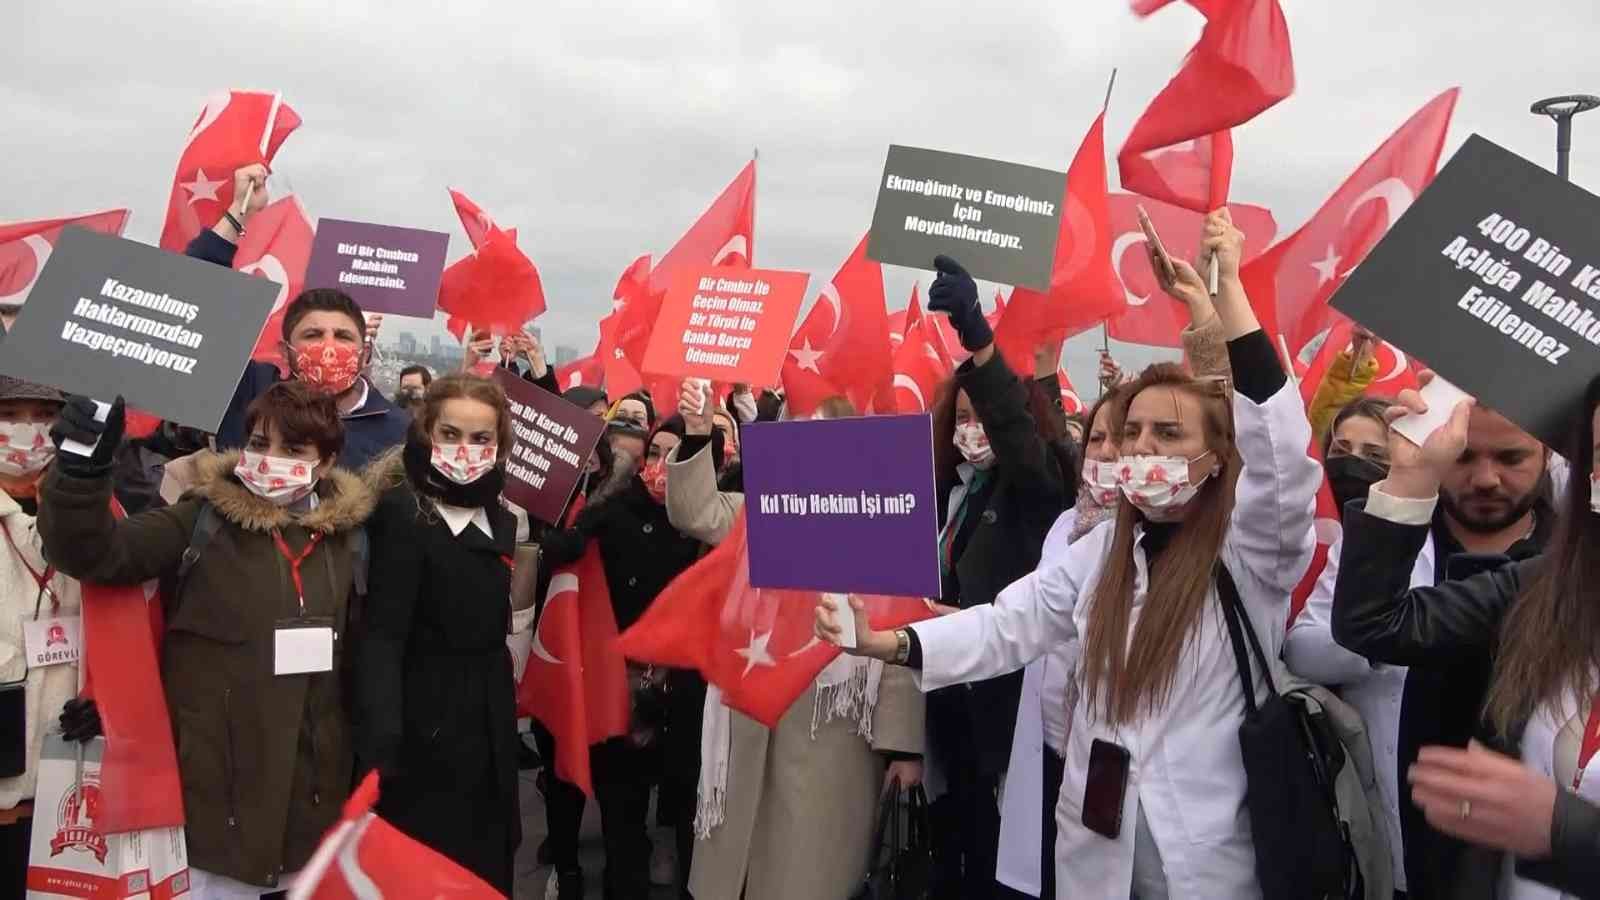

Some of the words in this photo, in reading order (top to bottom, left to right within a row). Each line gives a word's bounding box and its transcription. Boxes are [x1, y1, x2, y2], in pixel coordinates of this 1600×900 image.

[886, 174, 963, 199] Ekmeğimiz
[965, 188, 982, 202] ve
[984, 190, 1056, 217] Emeğimiz
[952, 202, 983, 222] İçin
[337, 242, 358, 256] Bizi
[358, 245, 375, 257] Bir
[904, 216, 1023, 250] Meydanlardayız.
[1441, 235, 1522, 293] Açlığa
[1476, 212, 1531, 252] 400
[1523, 237, 1573, 277] Bin
[1570, 263, 1600, 303] Ka
[100, 277, 200, 324] Kazanılmış
[698, 277, 717, 292] Bir
[716, 278, 754, 294] Cımbız
[692, 294, 728, 312] Geçim
[73, 297, 204, 349] Haklarımızdan
[689, 312, 708, 327] Bir
[707, 314, 741, 331] Törpü
[1457, 285, 1571, 366] Edilemez
[60, 320, 198, 375] Vazgeçmiyoruz
[682, 329, 718, 347] Banka
[717, 333, 752, 350] Borcu
[510, 400, 524, 416] an
[521, 406, 539, 423] Bir
[536, 413, 565, 438] Karar
[511, 440, 523, 457] in
[520, 447, 551, 472] Kadın
[760, 494, 780, 515] Kıl
[781, 494, 808, 516] Tüy
[810, 494, 859, 514] Hekim
[860, 489, 882, 520] İşi
[884, 493, 916, 515] mi?
